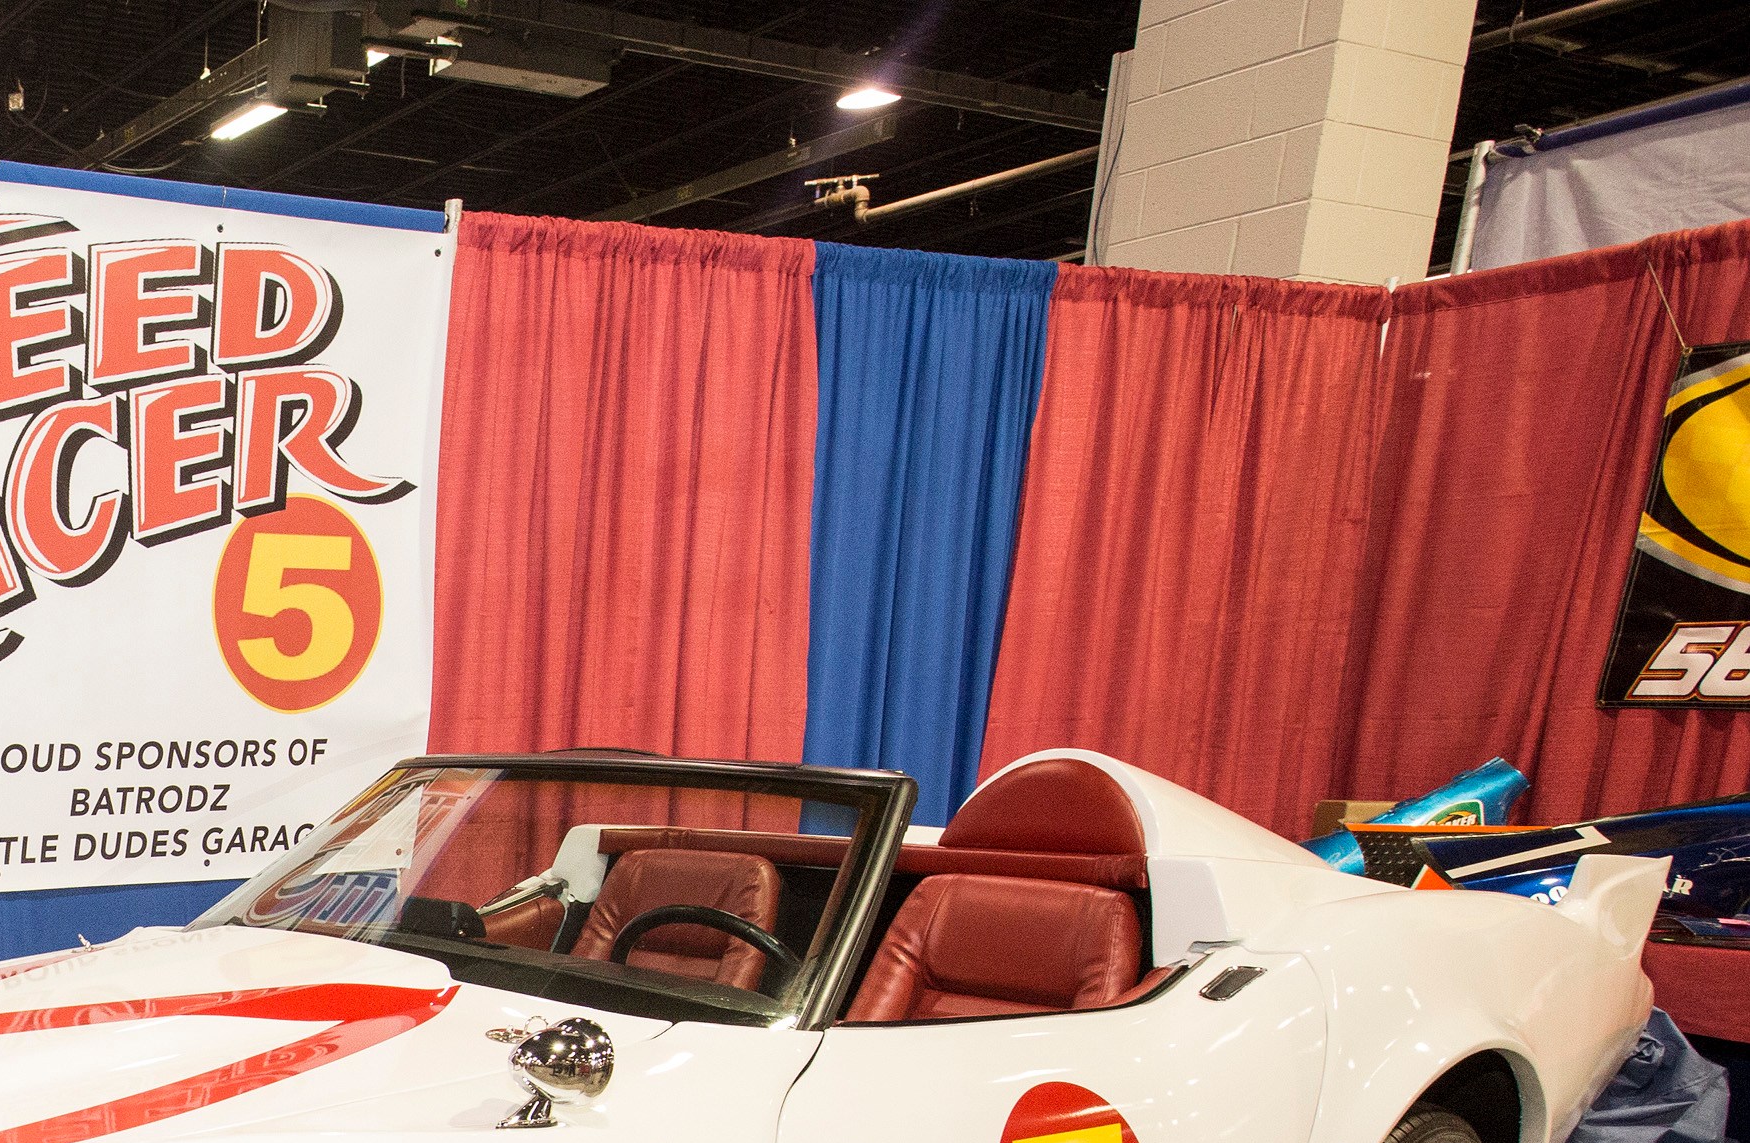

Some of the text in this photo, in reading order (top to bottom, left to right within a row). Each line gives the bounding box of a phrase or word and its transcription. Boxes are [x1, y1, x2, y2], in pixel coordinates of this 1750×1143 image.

[236, 531, 355, 682] 5
[94, 738, 277, 771] SPONSORS
[287, 738, 328, 766] OF
[69, 784, 231, 817] BATRODZ
[73, 828, 188, 861] DUDES
